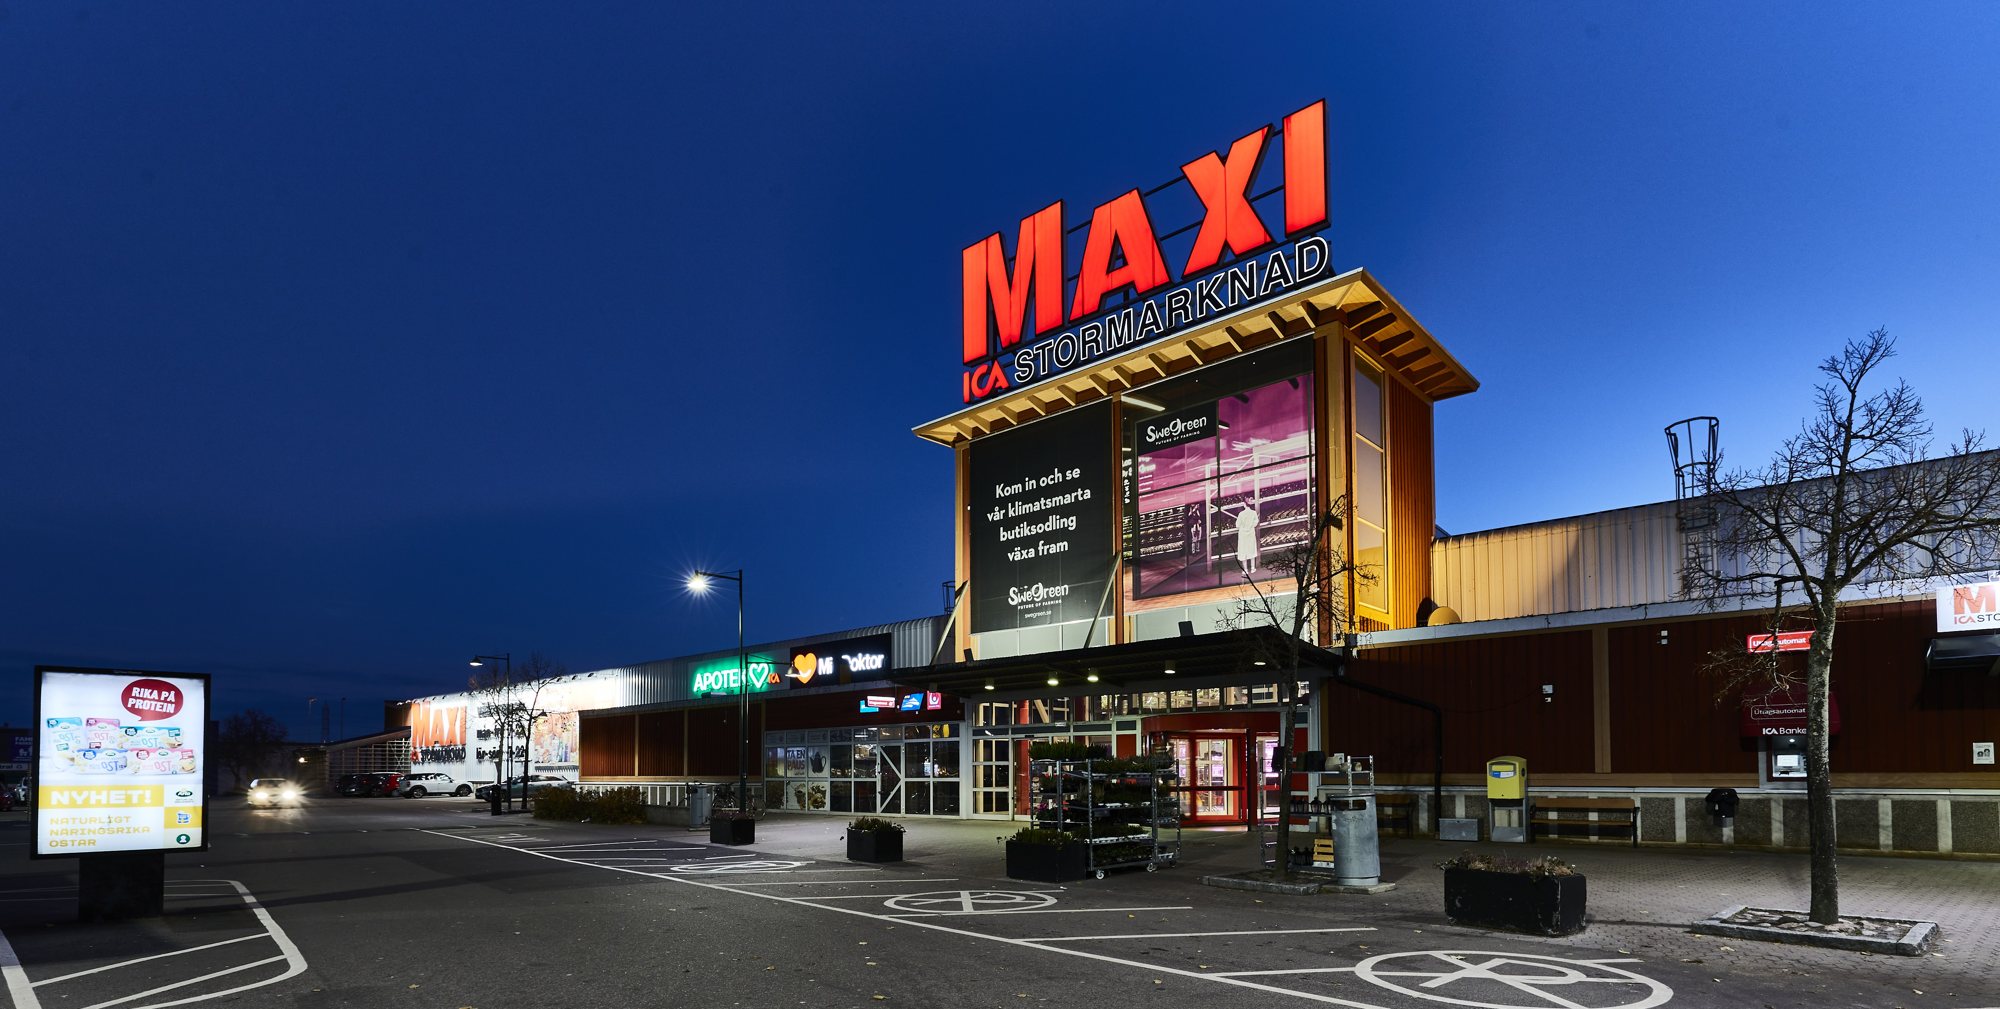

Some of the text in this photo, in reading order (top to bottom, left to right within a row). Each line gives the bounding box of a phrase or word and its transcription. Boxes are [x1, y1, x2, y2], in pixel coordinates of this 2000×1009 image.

[962, 98, 1330, 366] MAXI
[963, 236, 1330, 404] ICA STORMARKNAD
[995, 467, 1081, 498] Kom in och se
[986, 488, 1091, 522] vår klimatsmarta
[999, 514, 1077, 541] butiksodling
[1008, 540, 1069, 561] växa fram
[1954, 615, 1976, 625] ICA
[131, 687, 176, 702] RIKA PÅ
[127, 698, 175, 714] PROTEIN
[411, 700, 467, 748] MAXI
[797, 749, 806, 758] EN
[51, 789, 152, 806] NYHET!
[50, 815, 132, 825] NATURLIGT
[49, 838, 97, 848] OSTAR
